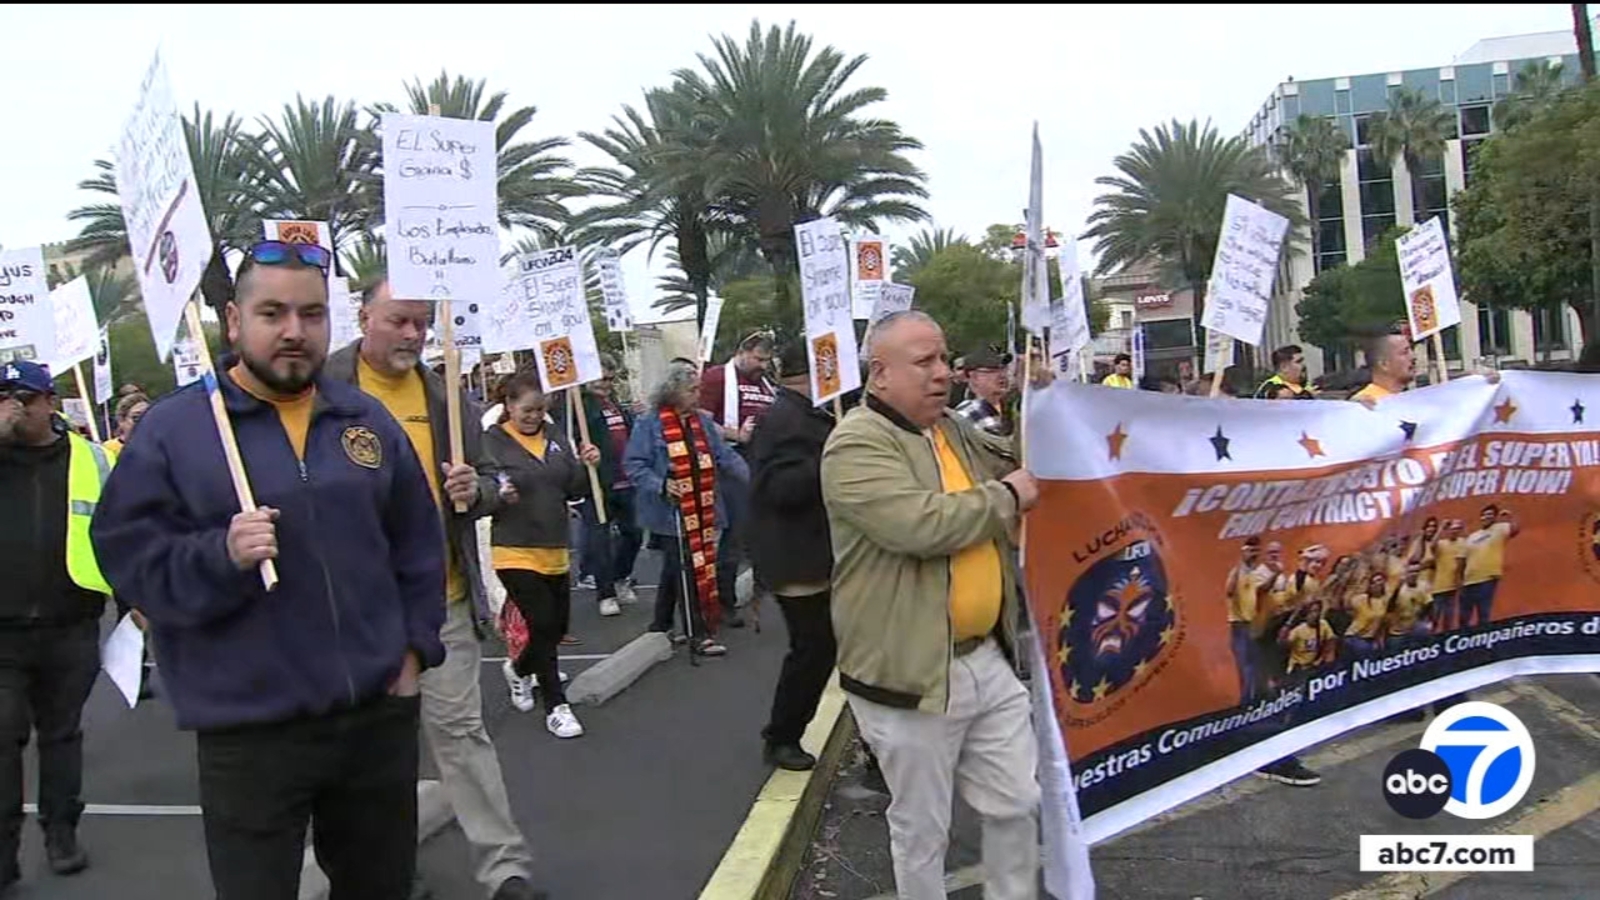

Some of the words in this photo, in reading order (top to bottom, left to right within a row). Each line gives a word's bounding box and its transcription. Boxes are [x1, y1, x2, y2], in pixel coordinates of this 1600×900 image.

[1483, 440, 1572, 468] SUPER
[1437, 469, 1500, 501] SUPER
[1501, 469, 1574, 495] NOW!
[1158, 687, 1302, 755] Comunidades
[1308, 670, 1347, 700] por
[1352, 643, 1431, 682] Nuestros
[1444, 619, 1575, 654] Compañeros
